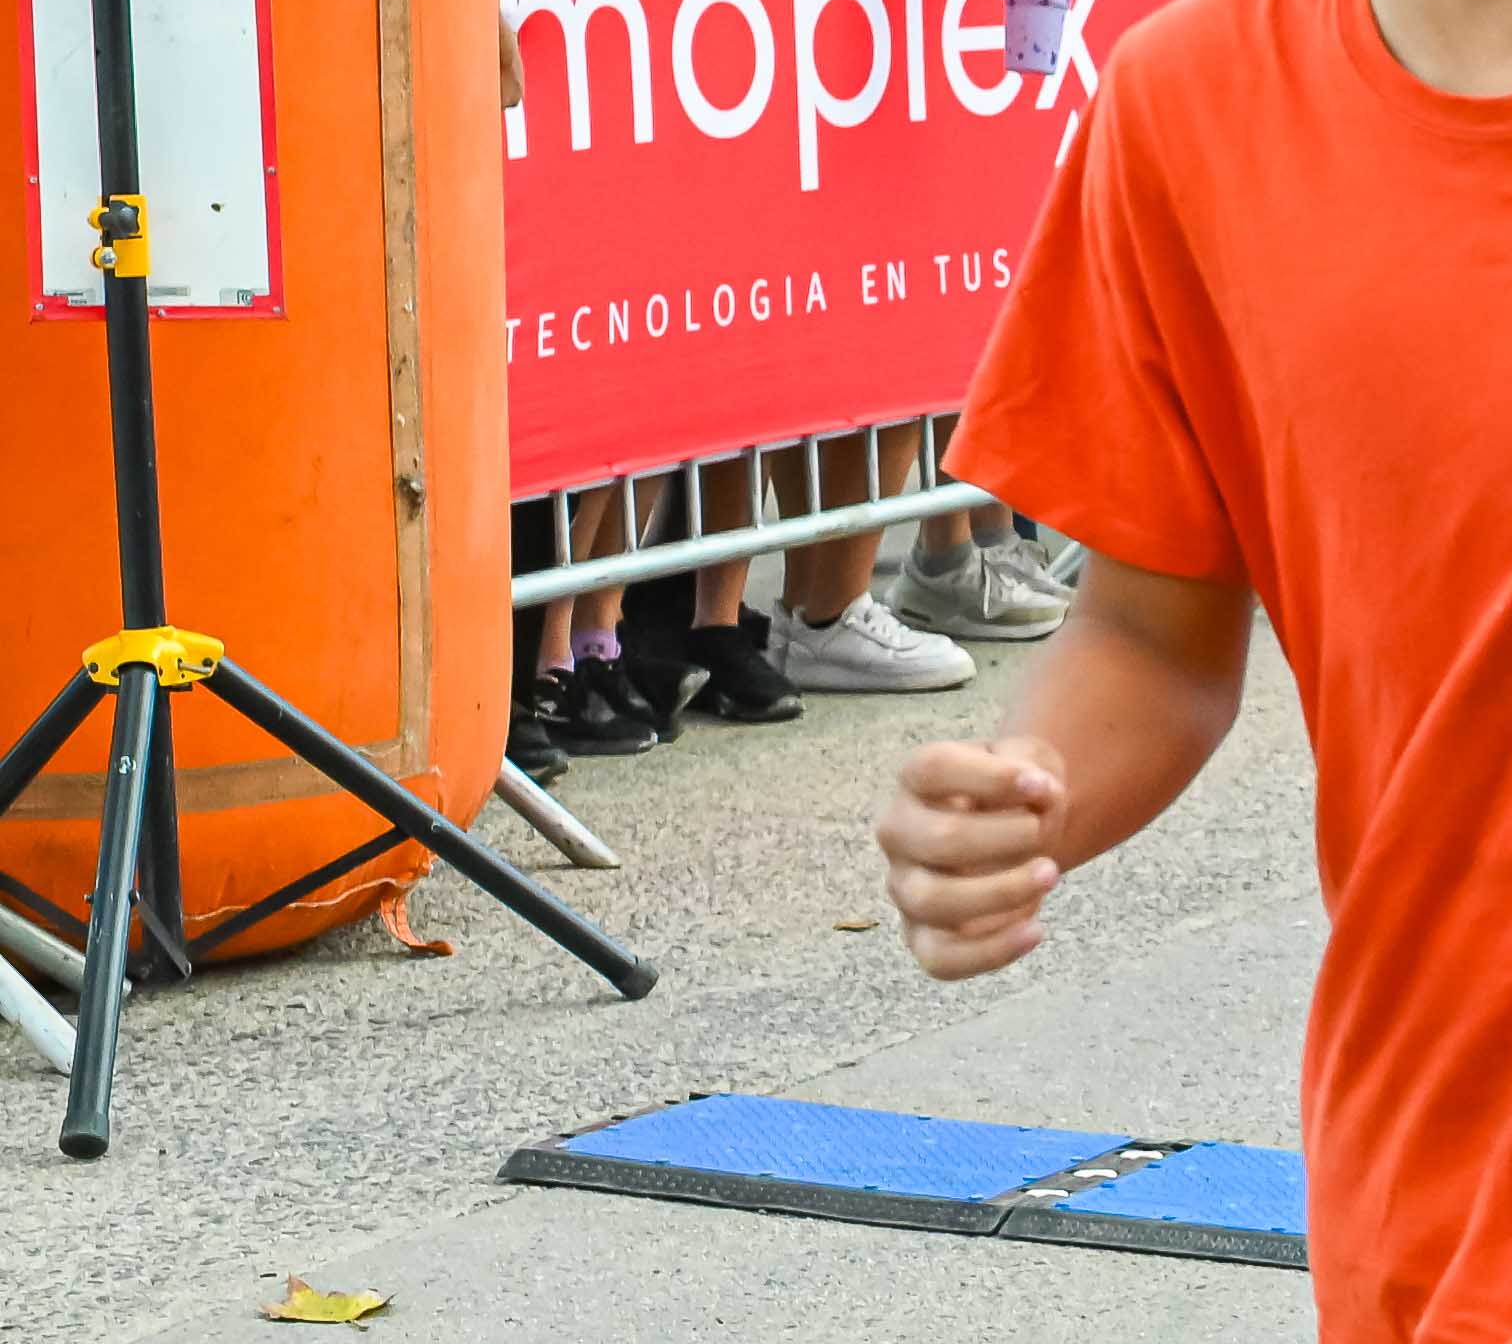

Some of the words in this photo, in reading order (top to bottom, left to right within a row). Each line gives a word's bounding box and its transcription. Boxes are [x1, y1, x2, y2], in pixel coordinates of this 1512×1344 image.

[503, 271, 828, 364] TECNOLOGIA
[860, 260, 908, 306] EN
[936, 247, 1013, 296] TUS
